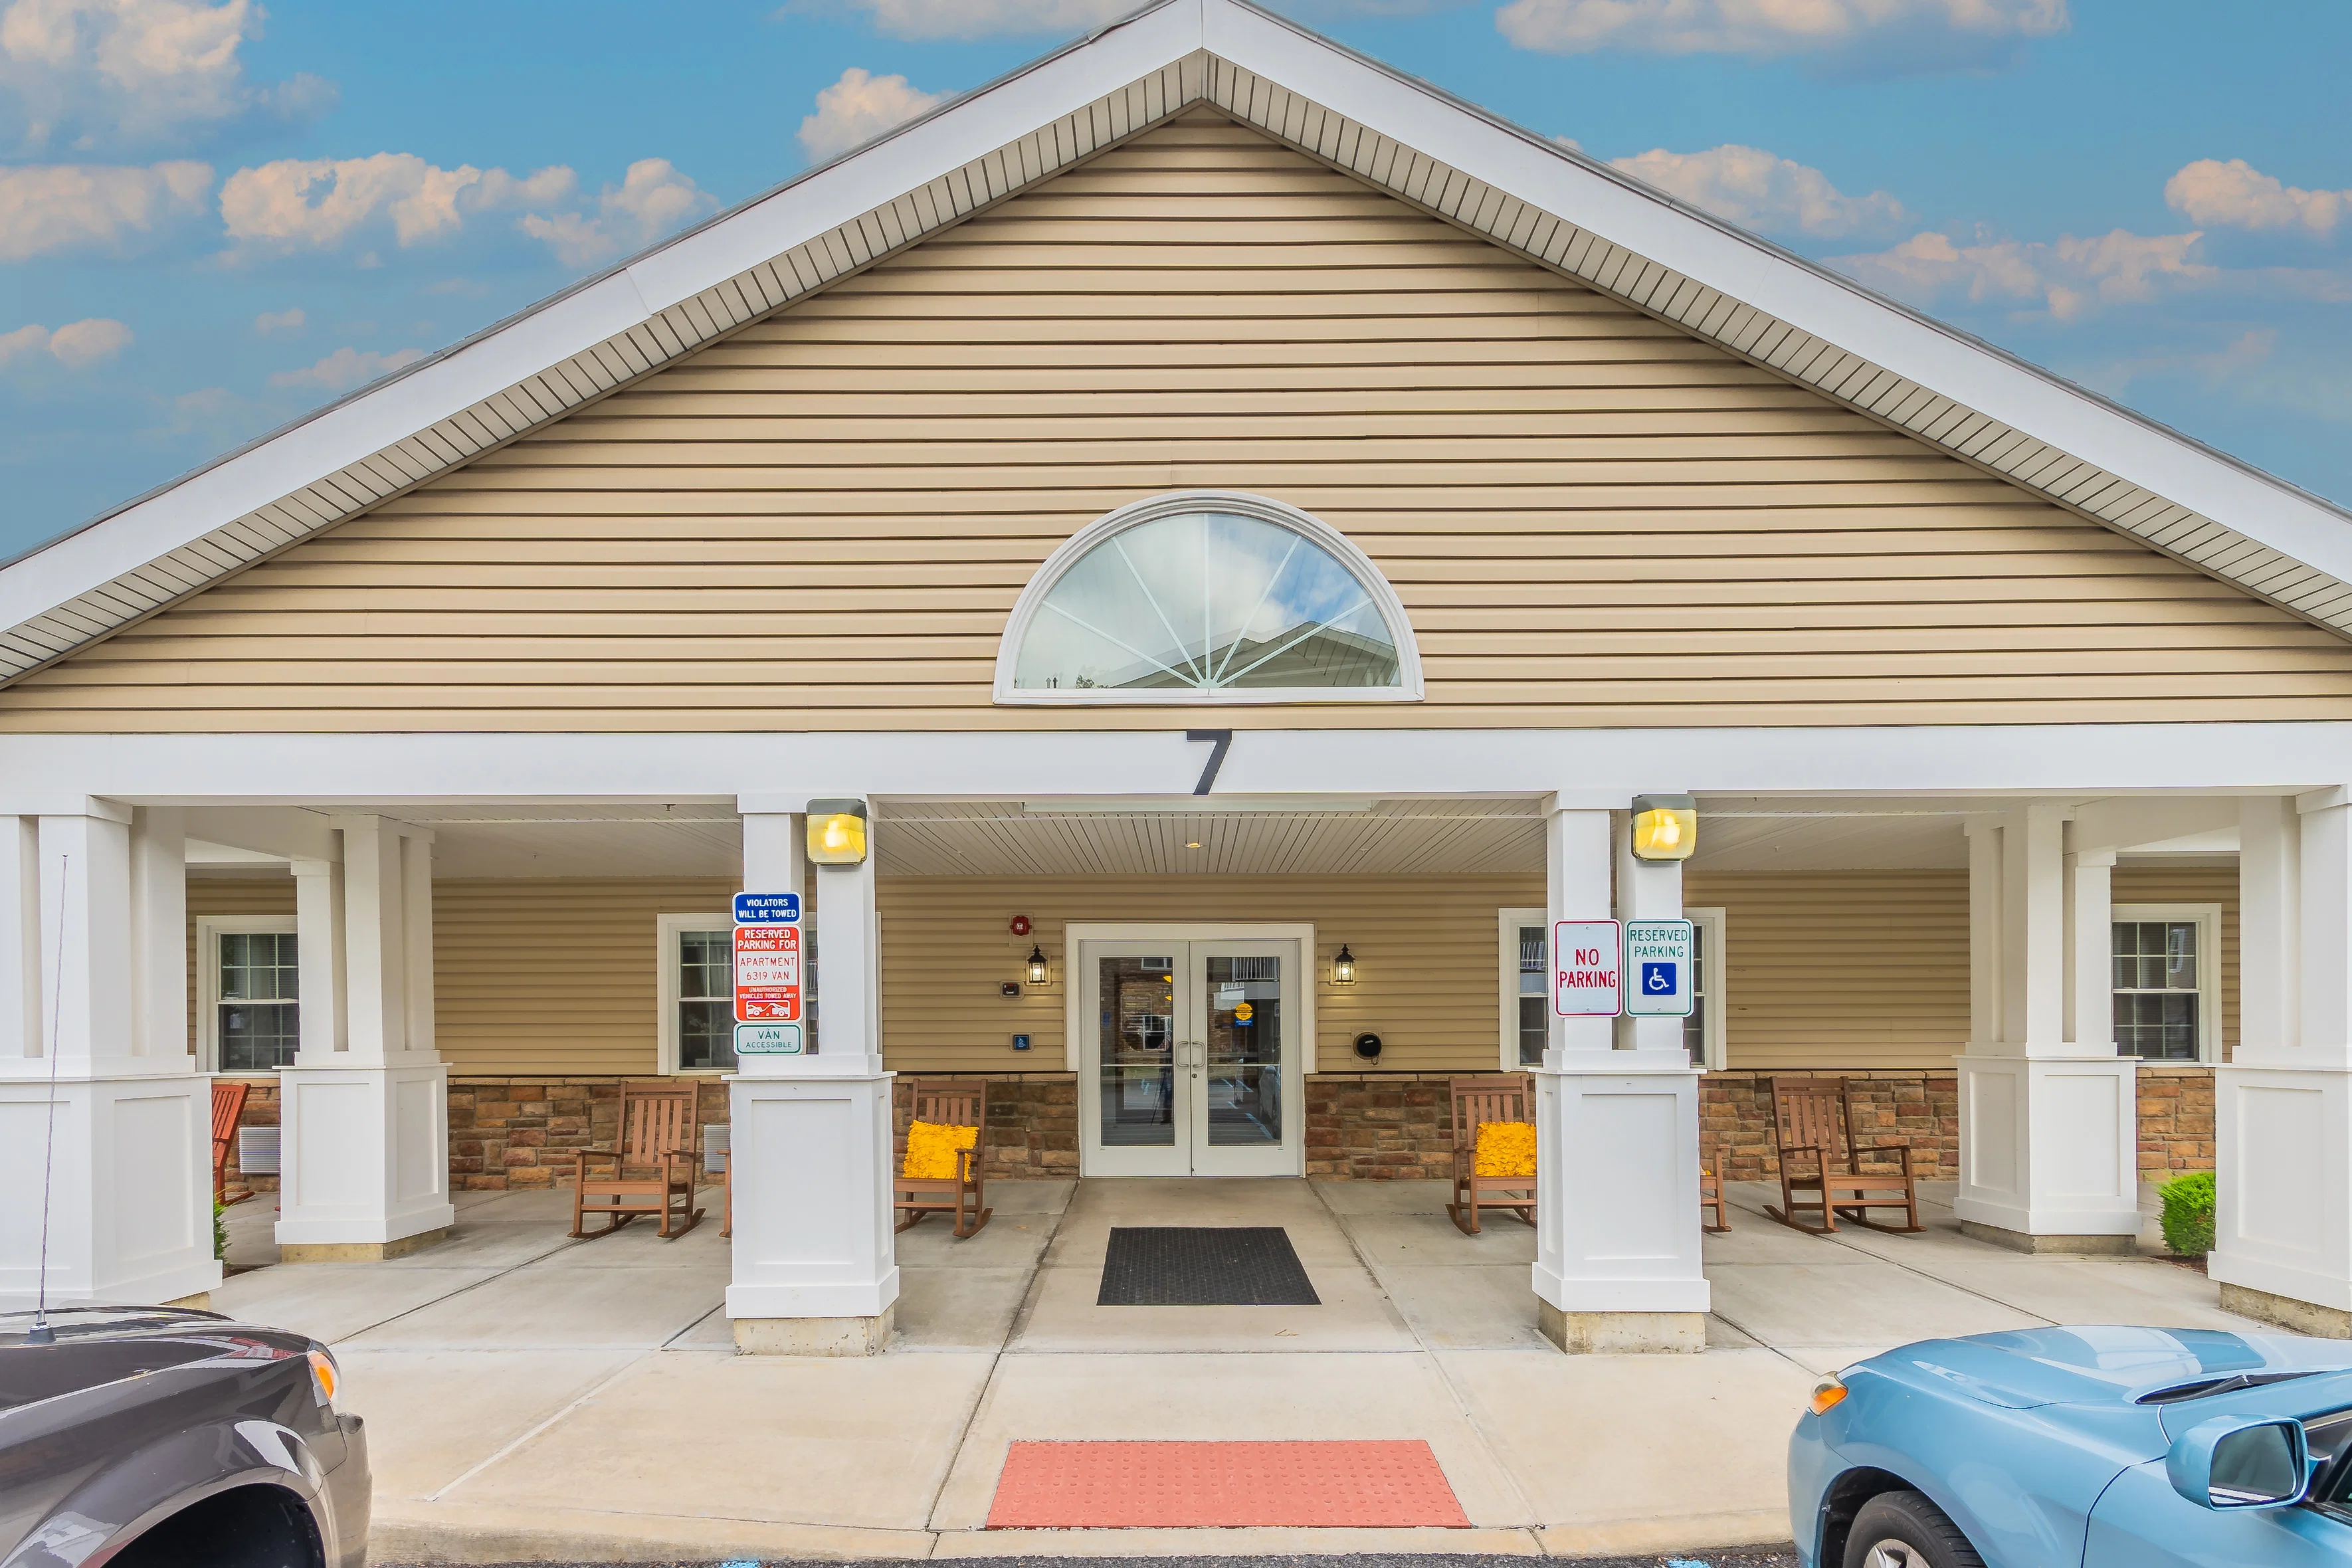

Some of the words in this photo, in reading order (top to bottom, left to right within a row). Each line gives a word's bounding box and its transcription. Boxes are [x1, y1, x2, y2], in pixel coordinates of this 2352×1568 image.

[1186, 728, 1232, 796] 7
[746, 898, 789, 907] VIOLATORS
[737, 910, 757, 918] WILL
[758, 910, 769, 918] BE
[771, 909, 797, 918] TOWED
[744, 929, 791, 939] RESERVED
[1630, 930, 1688, 941] RESERVED
[737, 939, 776, 949] PARKING
[779, 939, 797, 949] FOR
[1634, 945, 1684, 957] PARKING
[1575, 947, 1599, 966] NO
[739, 957, 795, 967] APARTMENT
[746, 971, 768, 981] 6319
[771, 971, 789, 980] VAN
[1559, 970, 1616, 989] PARKING
[757, 1030, 781, 1040] VAN
